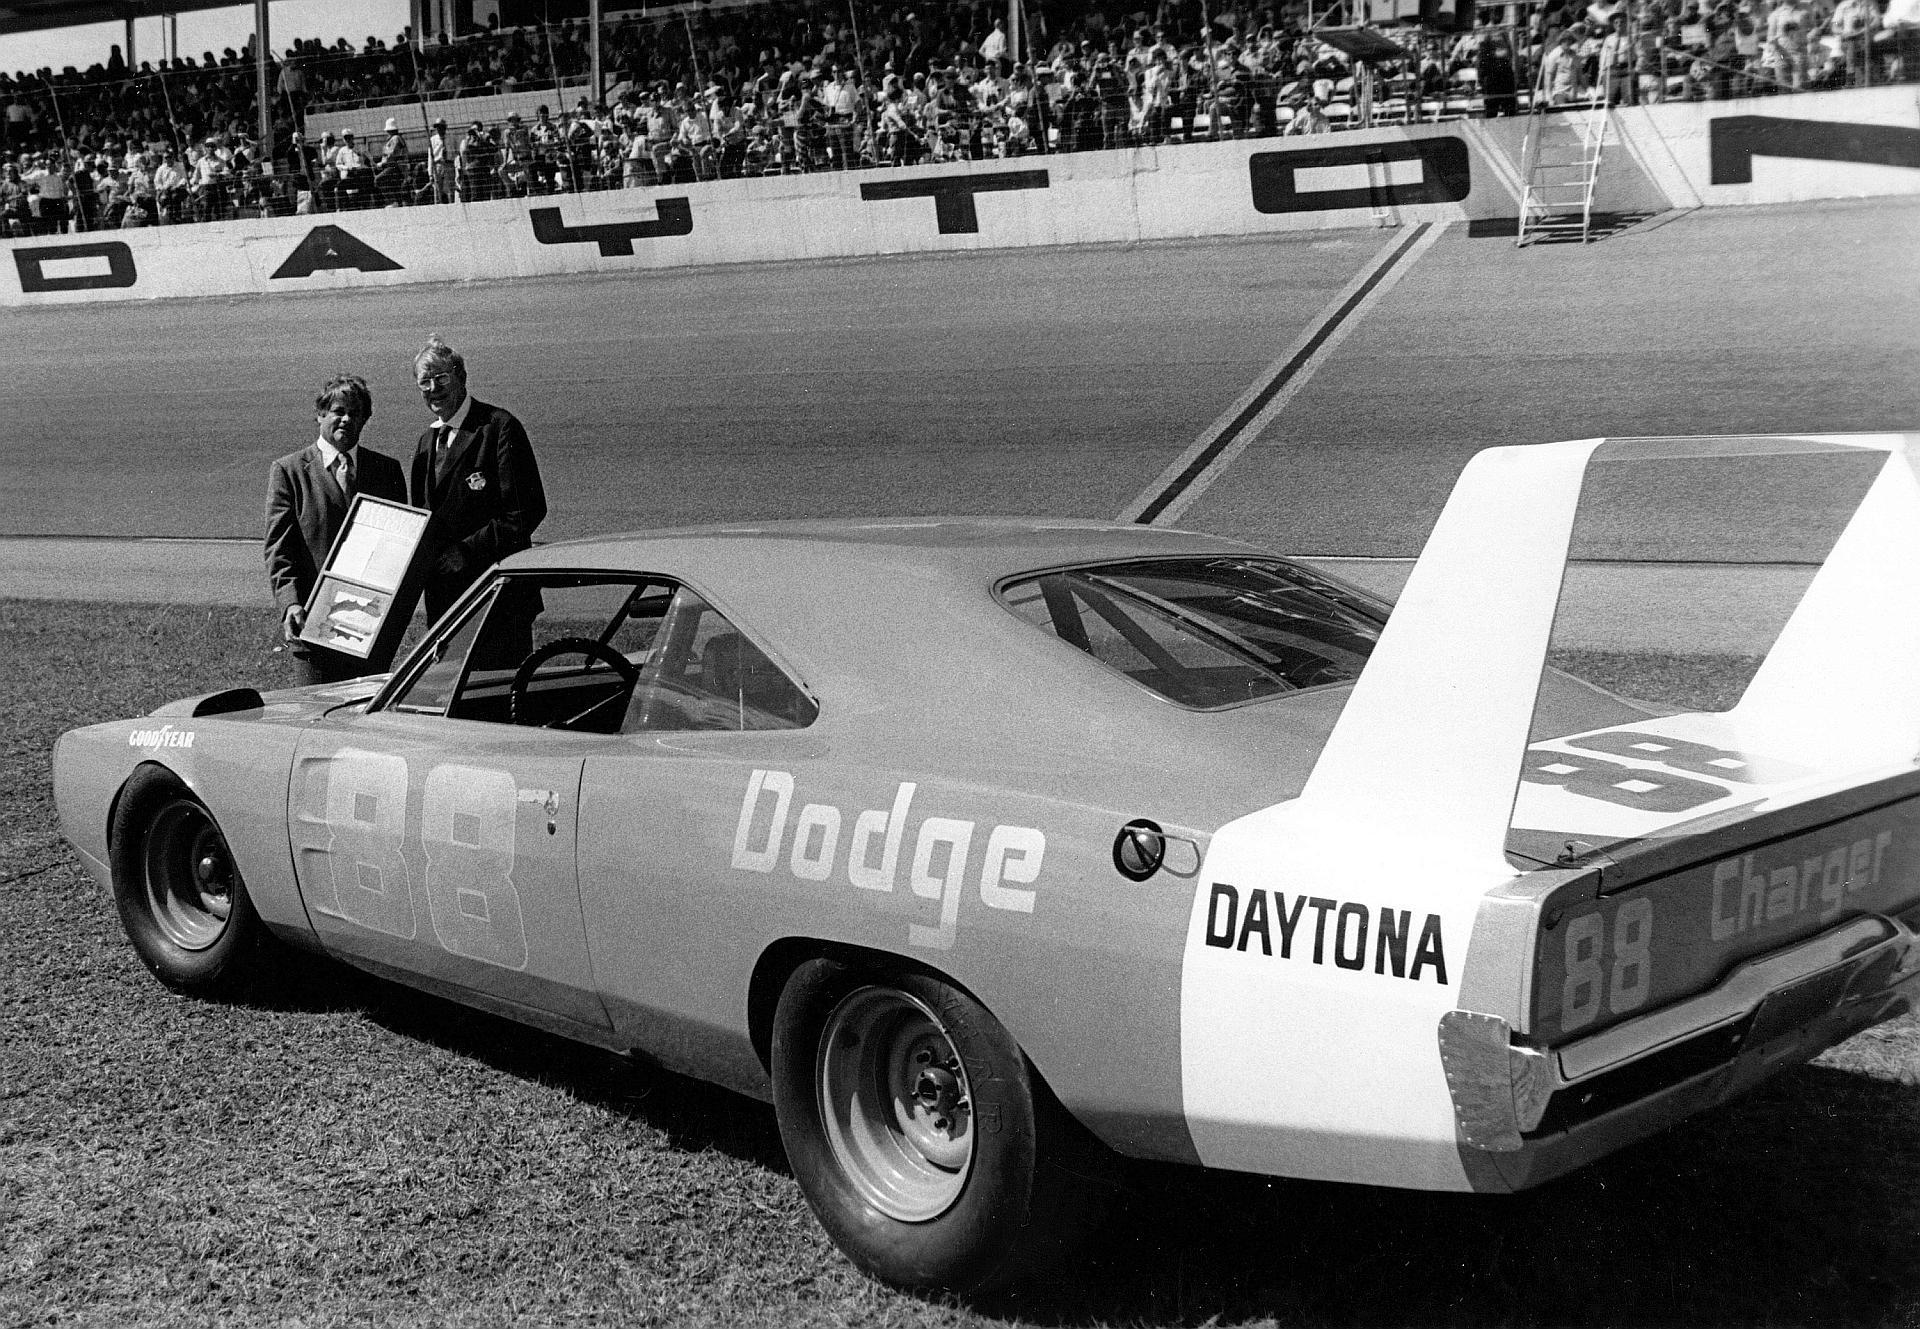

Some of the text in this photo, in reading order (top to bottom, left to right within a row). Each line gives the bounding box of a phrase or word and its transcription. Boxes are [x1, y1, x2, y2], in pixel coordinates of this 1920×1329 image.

[129, 725, 195, 752] GOODYEAR
[1519, 731, 1785, 813] 88
[326, 747, 528, 971] 88
[731, 769, 1046, 949] Dodge
[1205, 882, 1449, 986] DAYTONA
[1560, 831, 1892, 1033] 88 Charger
